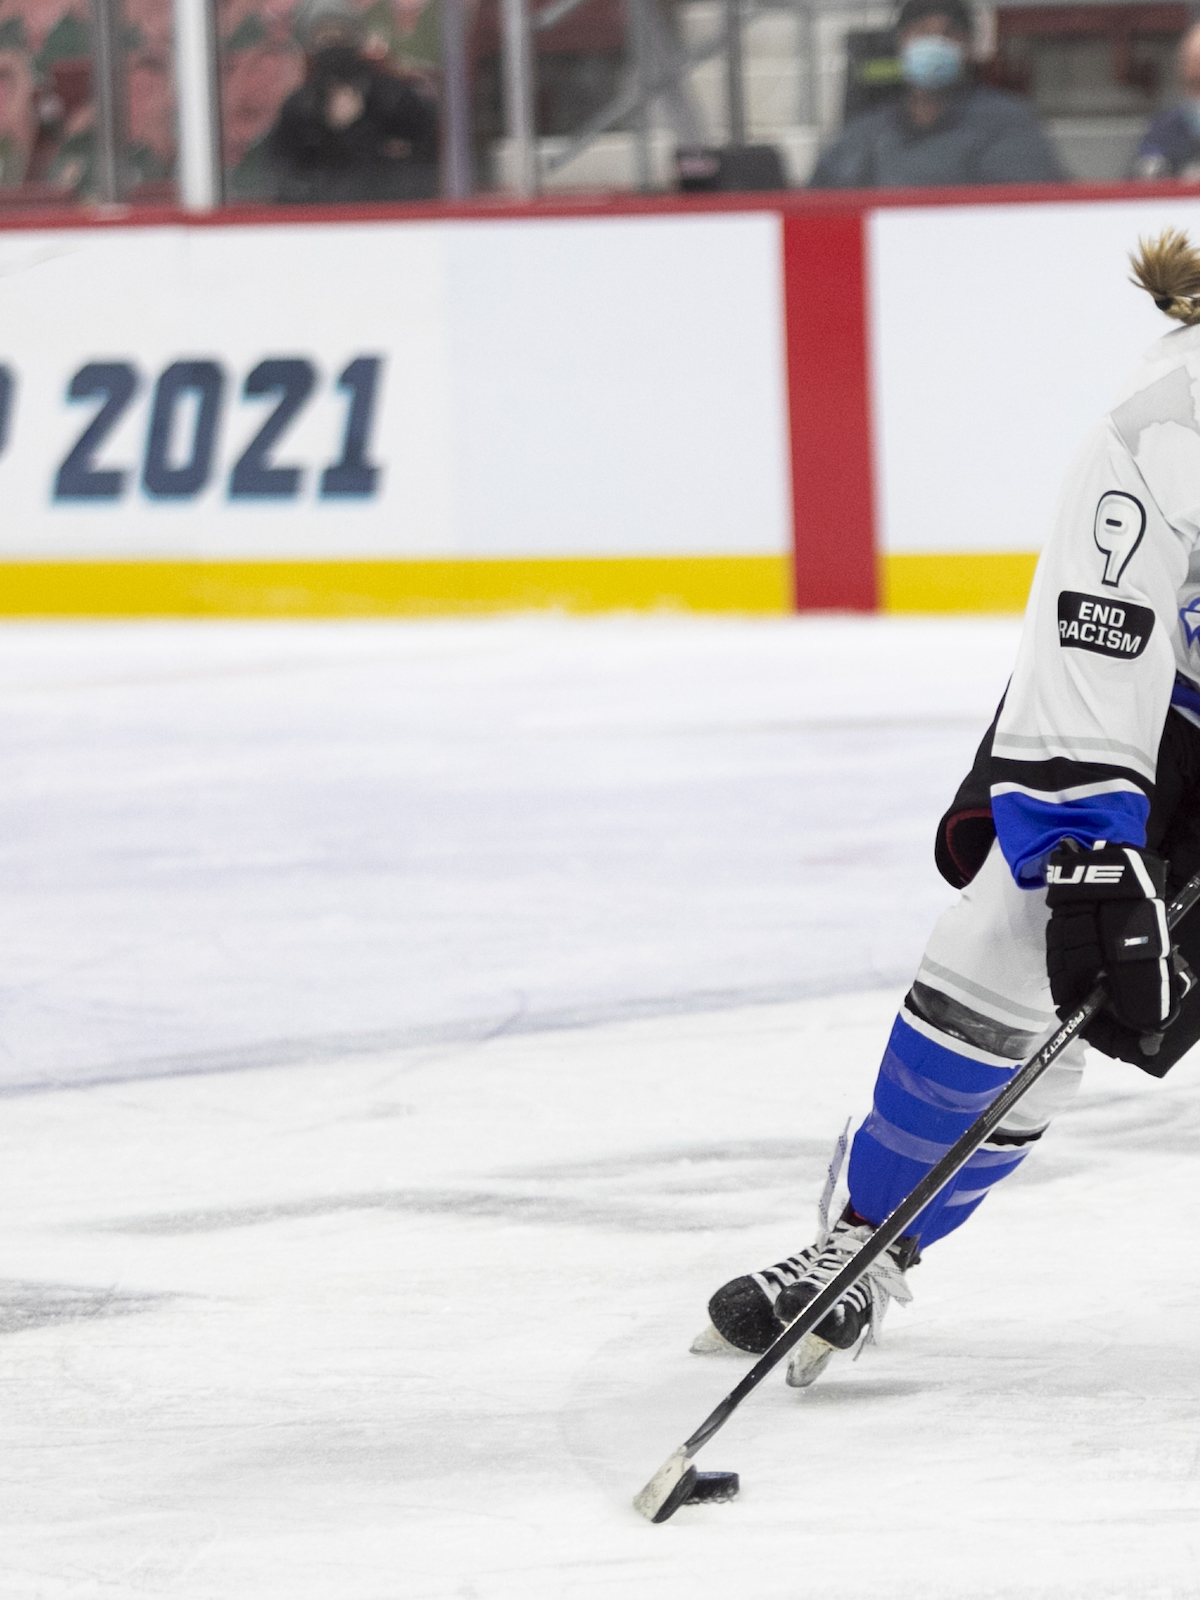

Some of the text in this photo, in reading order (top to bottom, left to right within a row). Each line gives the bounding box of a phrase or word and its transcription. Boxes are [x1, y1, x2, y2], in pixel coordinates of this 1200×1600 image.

[52, 356, 386, 503] 2021
[1093, 489, 1147, 588] 9
[1059, 620, 1142, 653] RACISM
[1078, 601, 1126, 628] END
